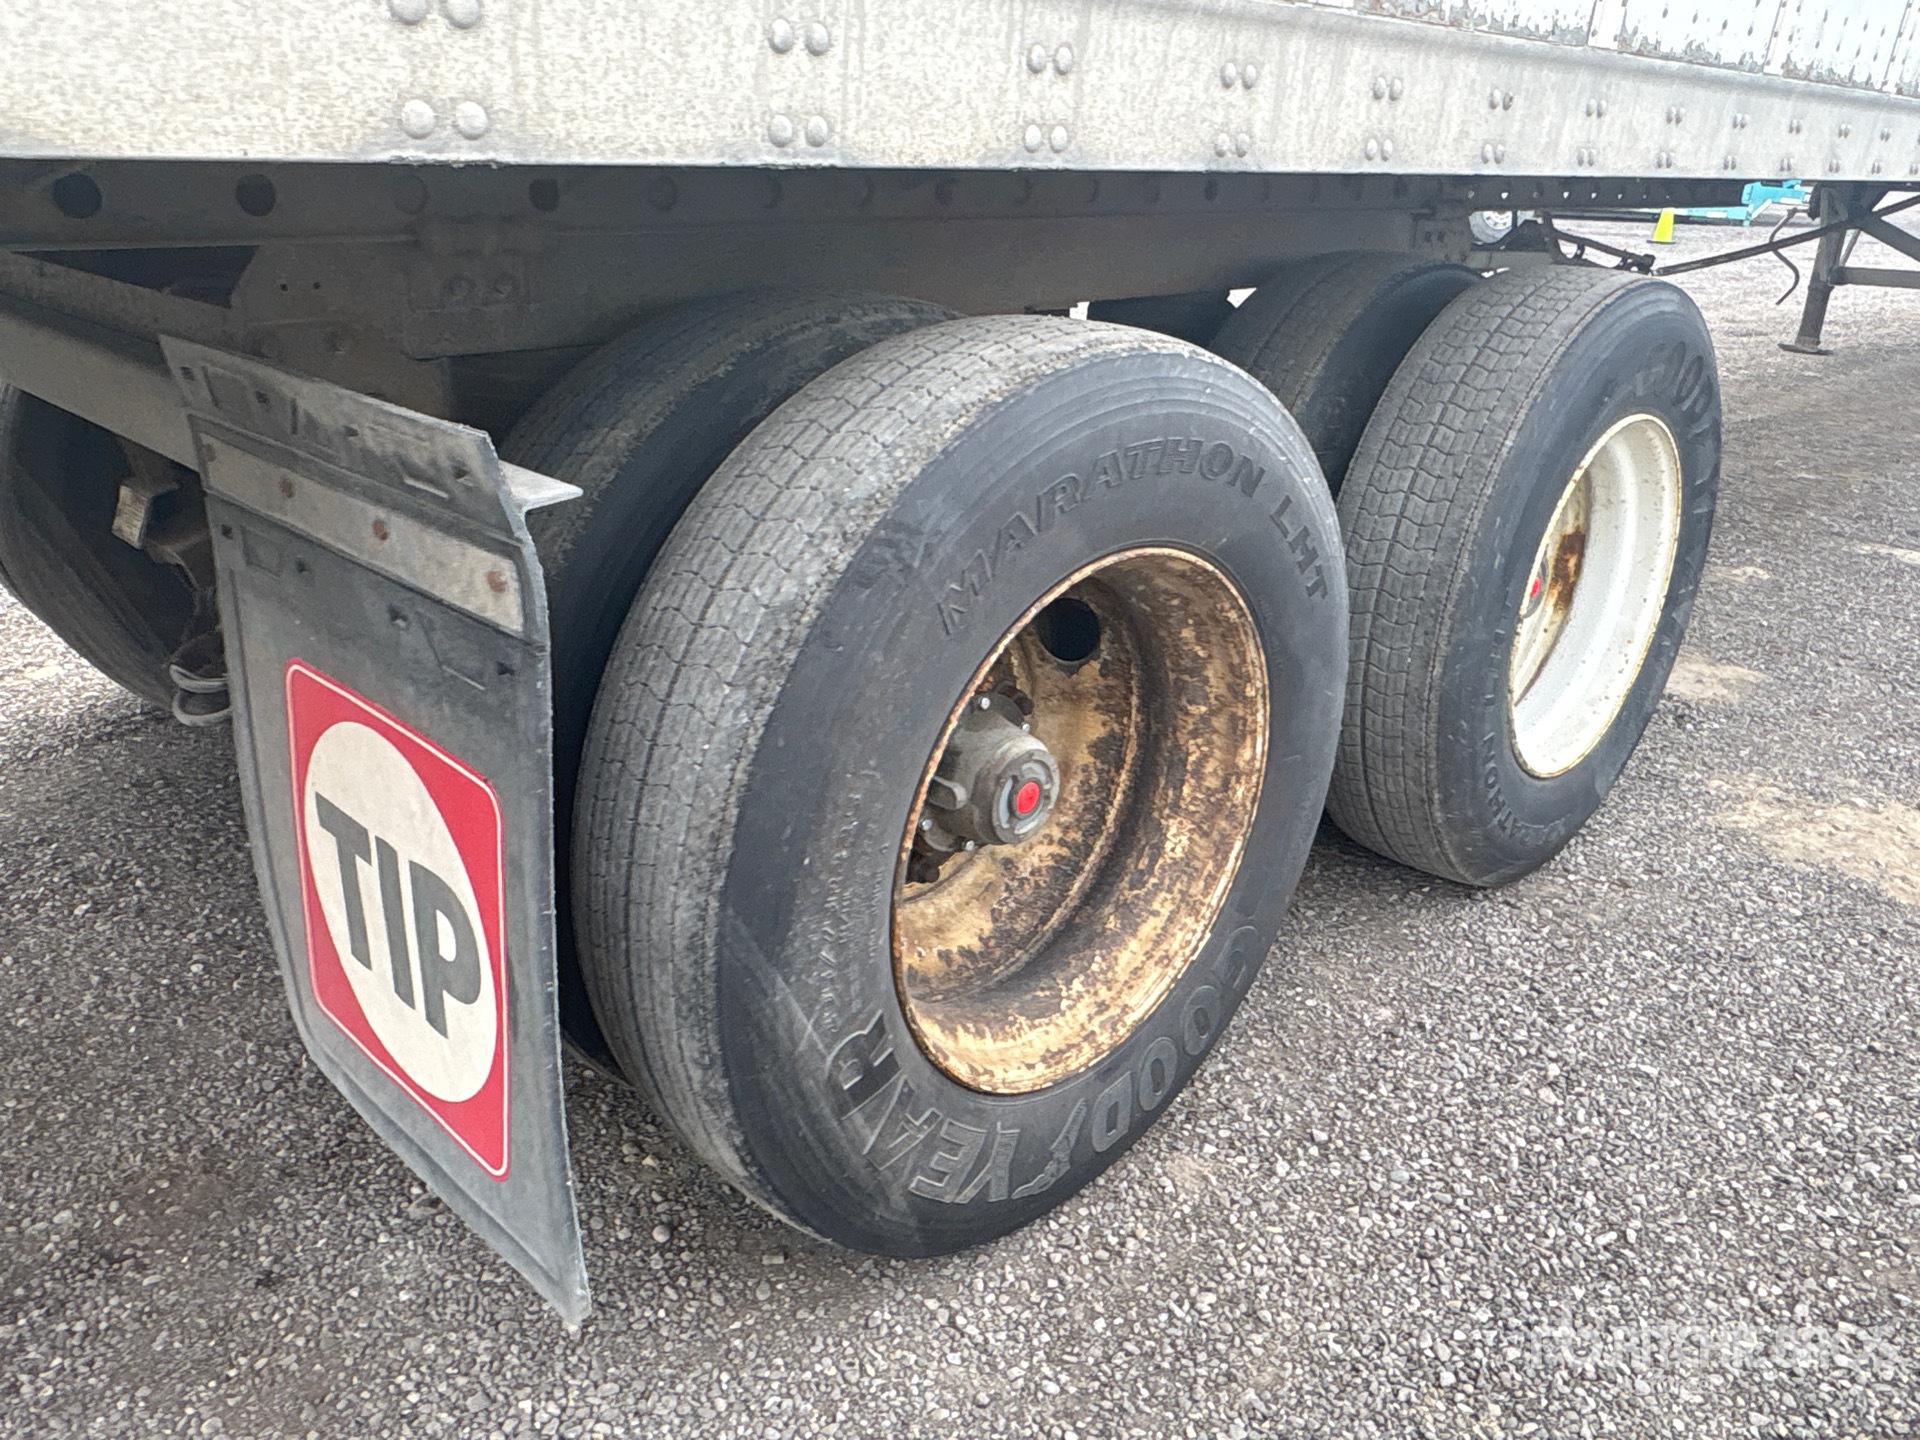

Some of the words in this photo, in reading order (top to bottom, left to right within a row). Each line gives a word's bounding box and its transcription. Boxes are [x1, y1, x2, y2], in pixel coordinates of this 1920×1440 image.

[938, 437, 1266, 636] MARATHON
[1270, 495, 1329, 600] LHT
[315, 791, 481, 1040] TIP
